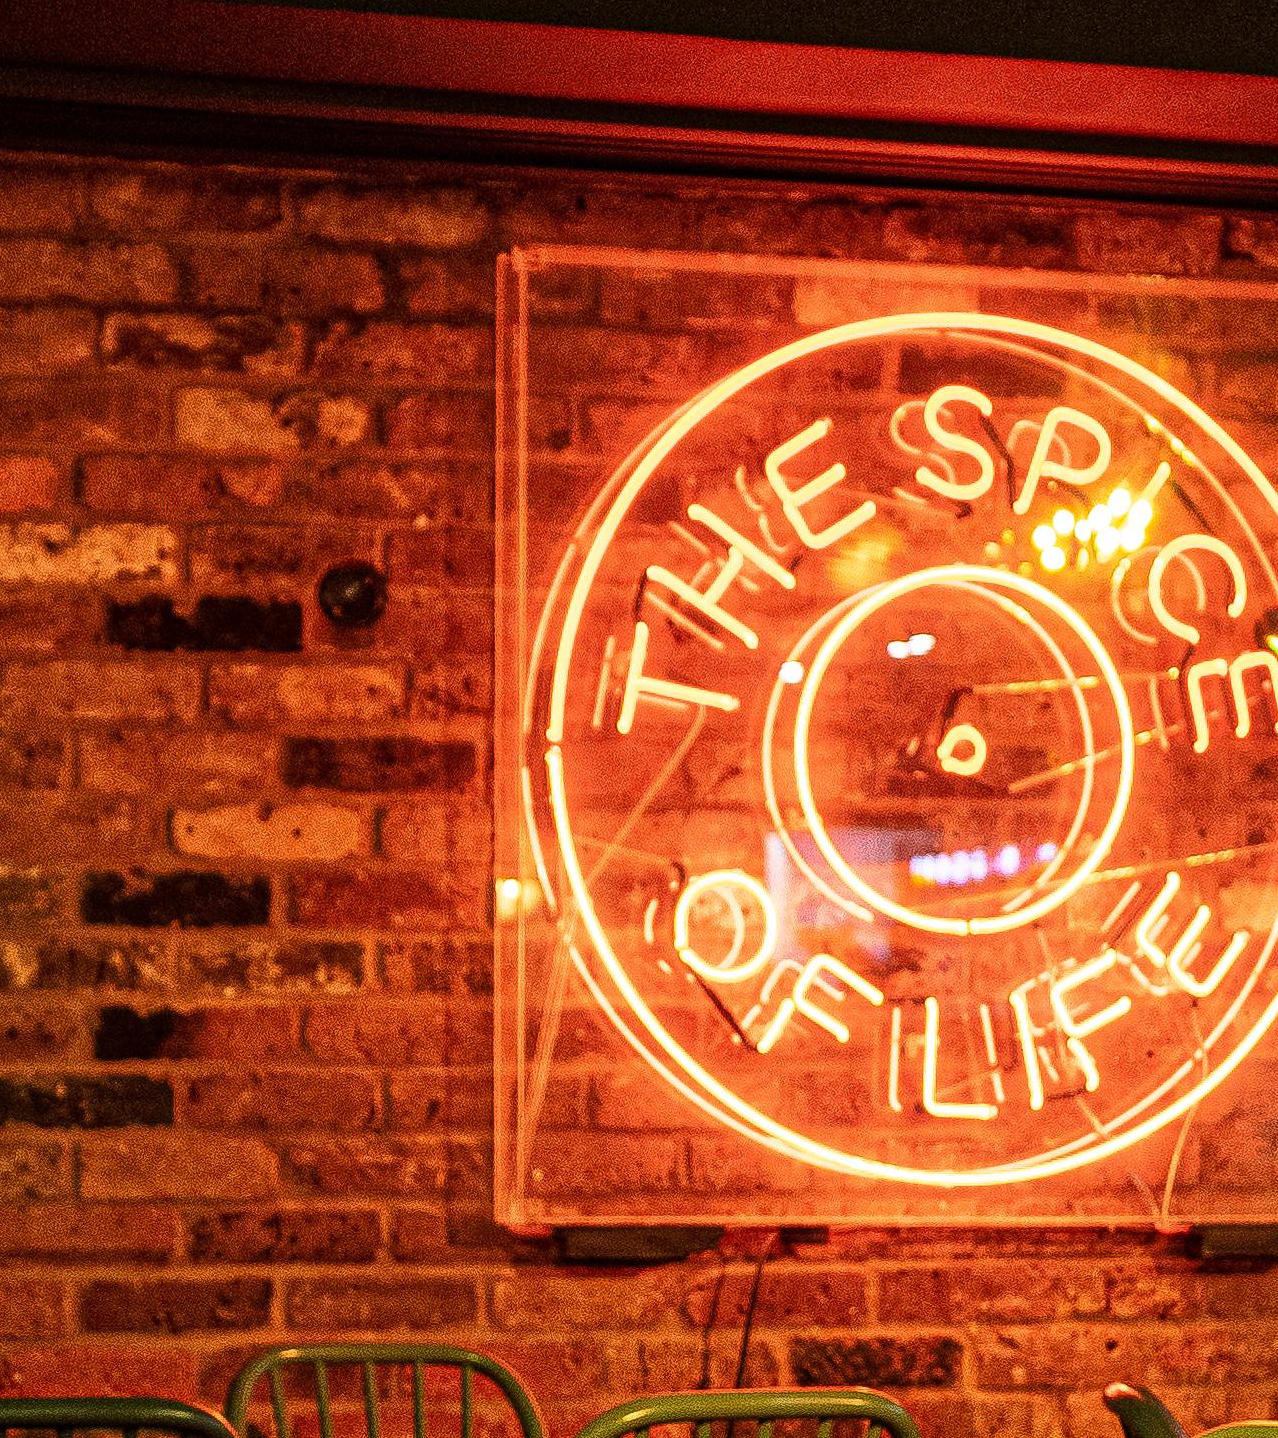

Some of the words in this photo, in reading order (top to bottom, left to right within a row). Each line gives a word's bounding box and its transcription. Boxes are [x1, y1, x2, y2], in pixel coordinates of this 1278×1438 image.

[617, 417, 877, 736] THE
[675, 870, 884, 1055] OF
[924, 871, 1252, 1120] LIFE
